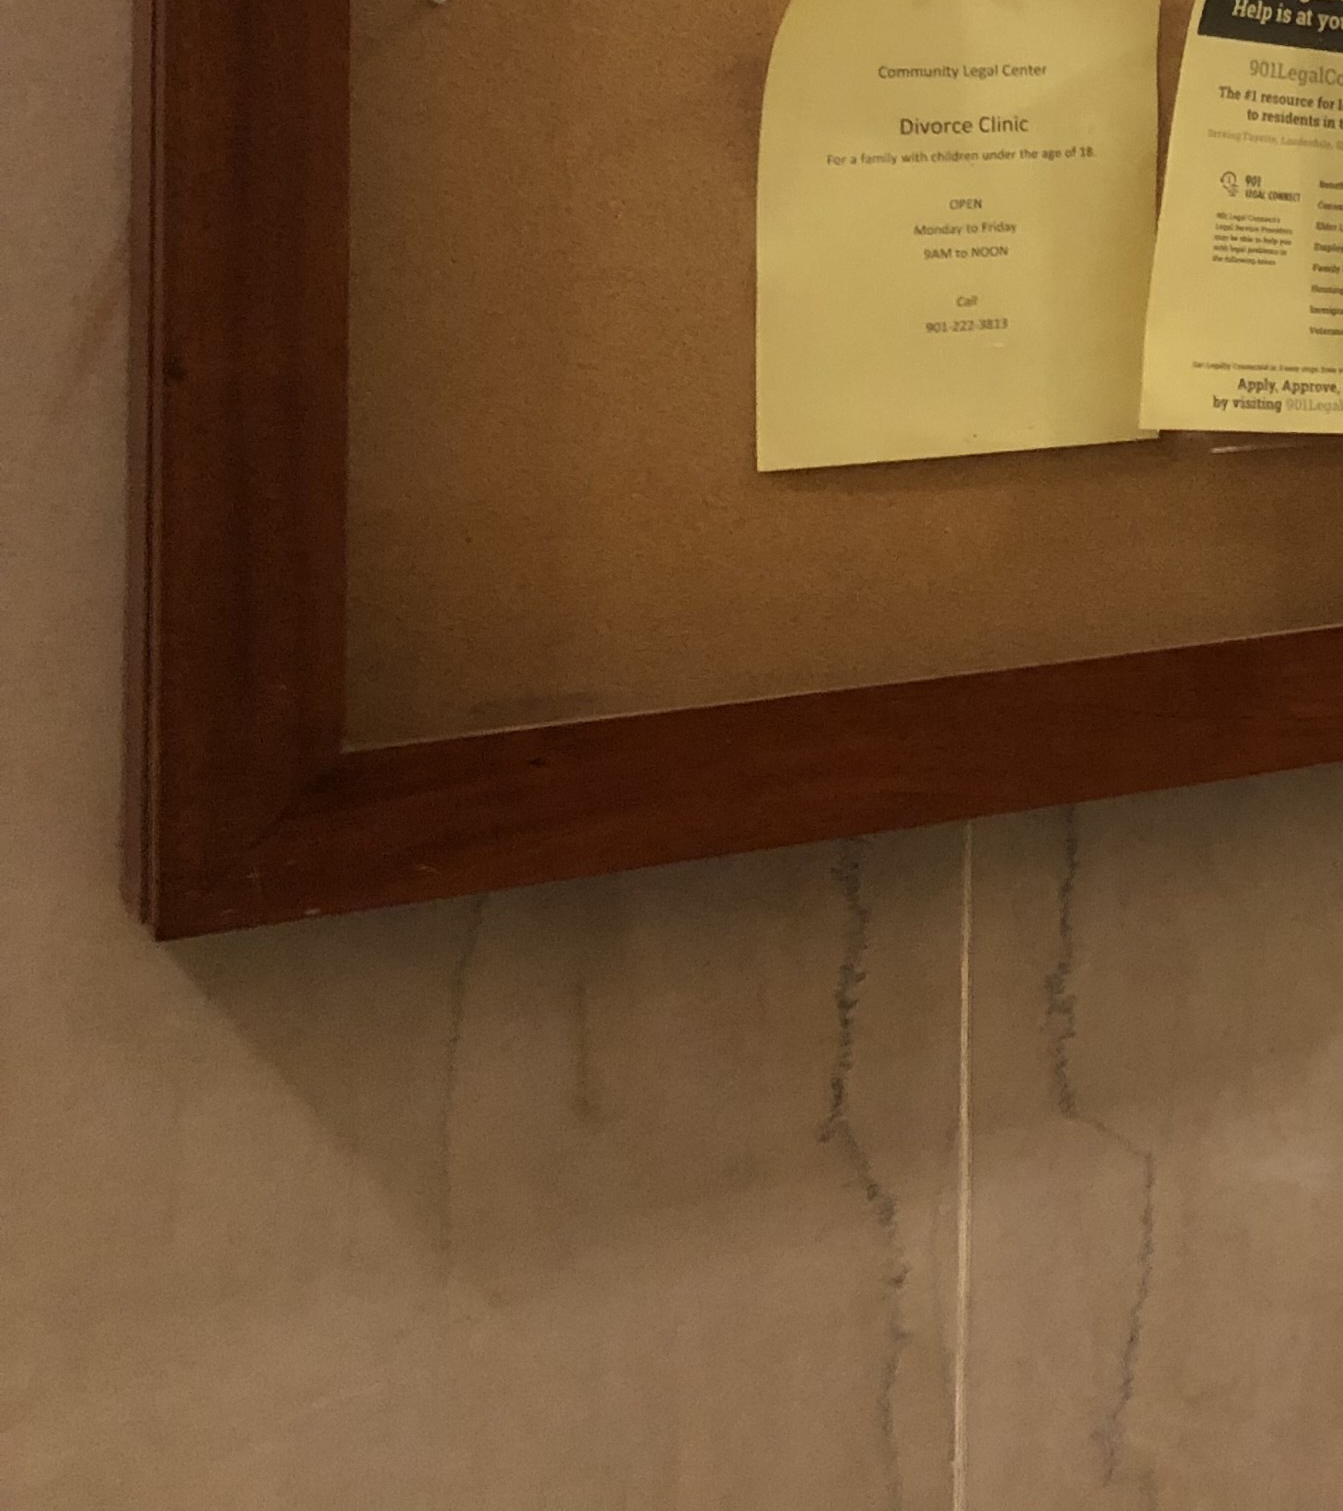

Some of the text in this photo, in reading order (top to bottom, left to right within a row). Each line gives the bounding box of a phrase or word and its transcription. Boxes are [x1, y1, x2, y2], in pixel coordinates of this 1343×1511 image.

[1276, 3, 1292, 21] is
[1296, 7, 1312, 26] at
[878, 63, 1047, 82] Community Legal Center
[1219, 86, 1240, 101] The
[1244, 89, 1256, 102] #1
[1260, 94, 1314, 108] resource
[1317, 96, 1334, 110] for
[900, 115, 1029, 135] Divorce Clinic
[1247, 108, 1258, 121] to
[1262, 109, 1320, 127] residents
[1323, 115, 1335, 128] in
[851, 155, 858, 164] a
[1065, 146, 1077, 158] of
[950, 197, 983, 210] OPEN
[914, 219, 1017, 239] Monday to Friday
[924, 244, 1009, 259] 9AM to NOON
[957, 294, 979, 308] Call
[1238, 378, 1279, 396] Apply,
[1283, 379, 1340, 397] Approve,
[1213, 396, 1228, 412] by
[1233, 397, 1282, 413] visiting
